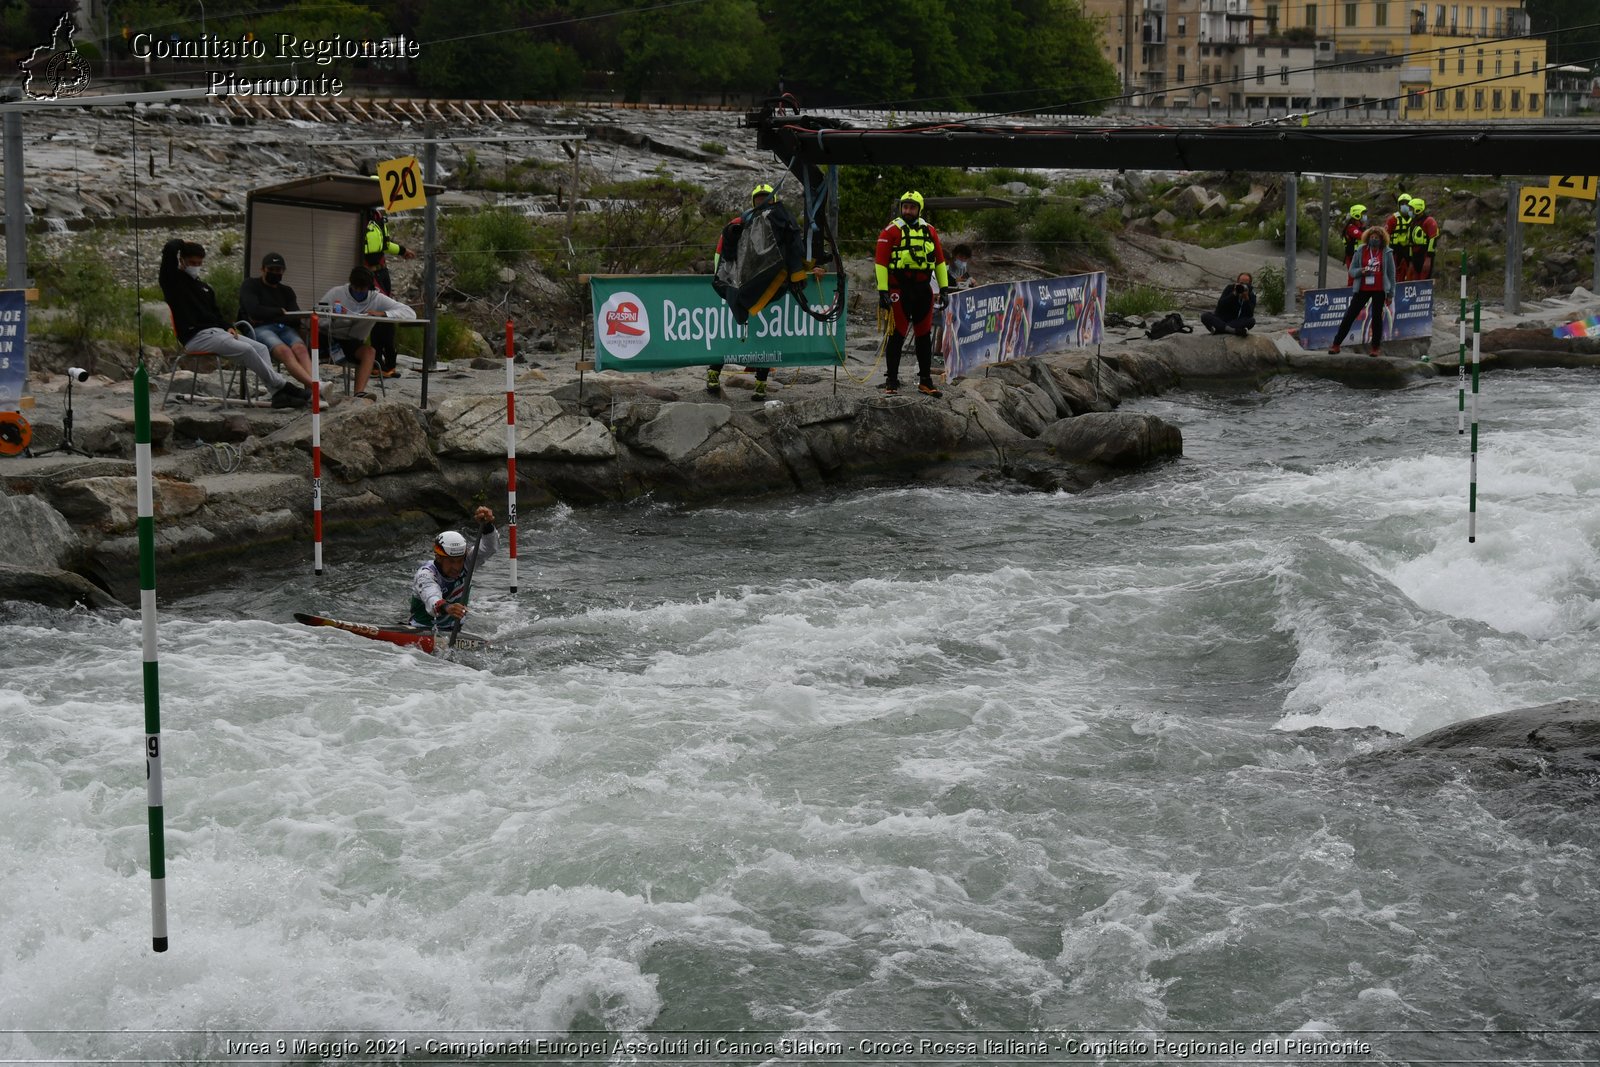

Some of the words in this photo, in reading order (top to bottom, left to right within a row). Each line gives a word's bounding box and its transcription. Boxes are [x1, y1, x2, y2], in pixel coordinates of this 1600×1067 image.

[386, 167, 417, 201] 20
[1524, 195, 1551, 217] 22
[607, 312, 637, 321] RASPINI
